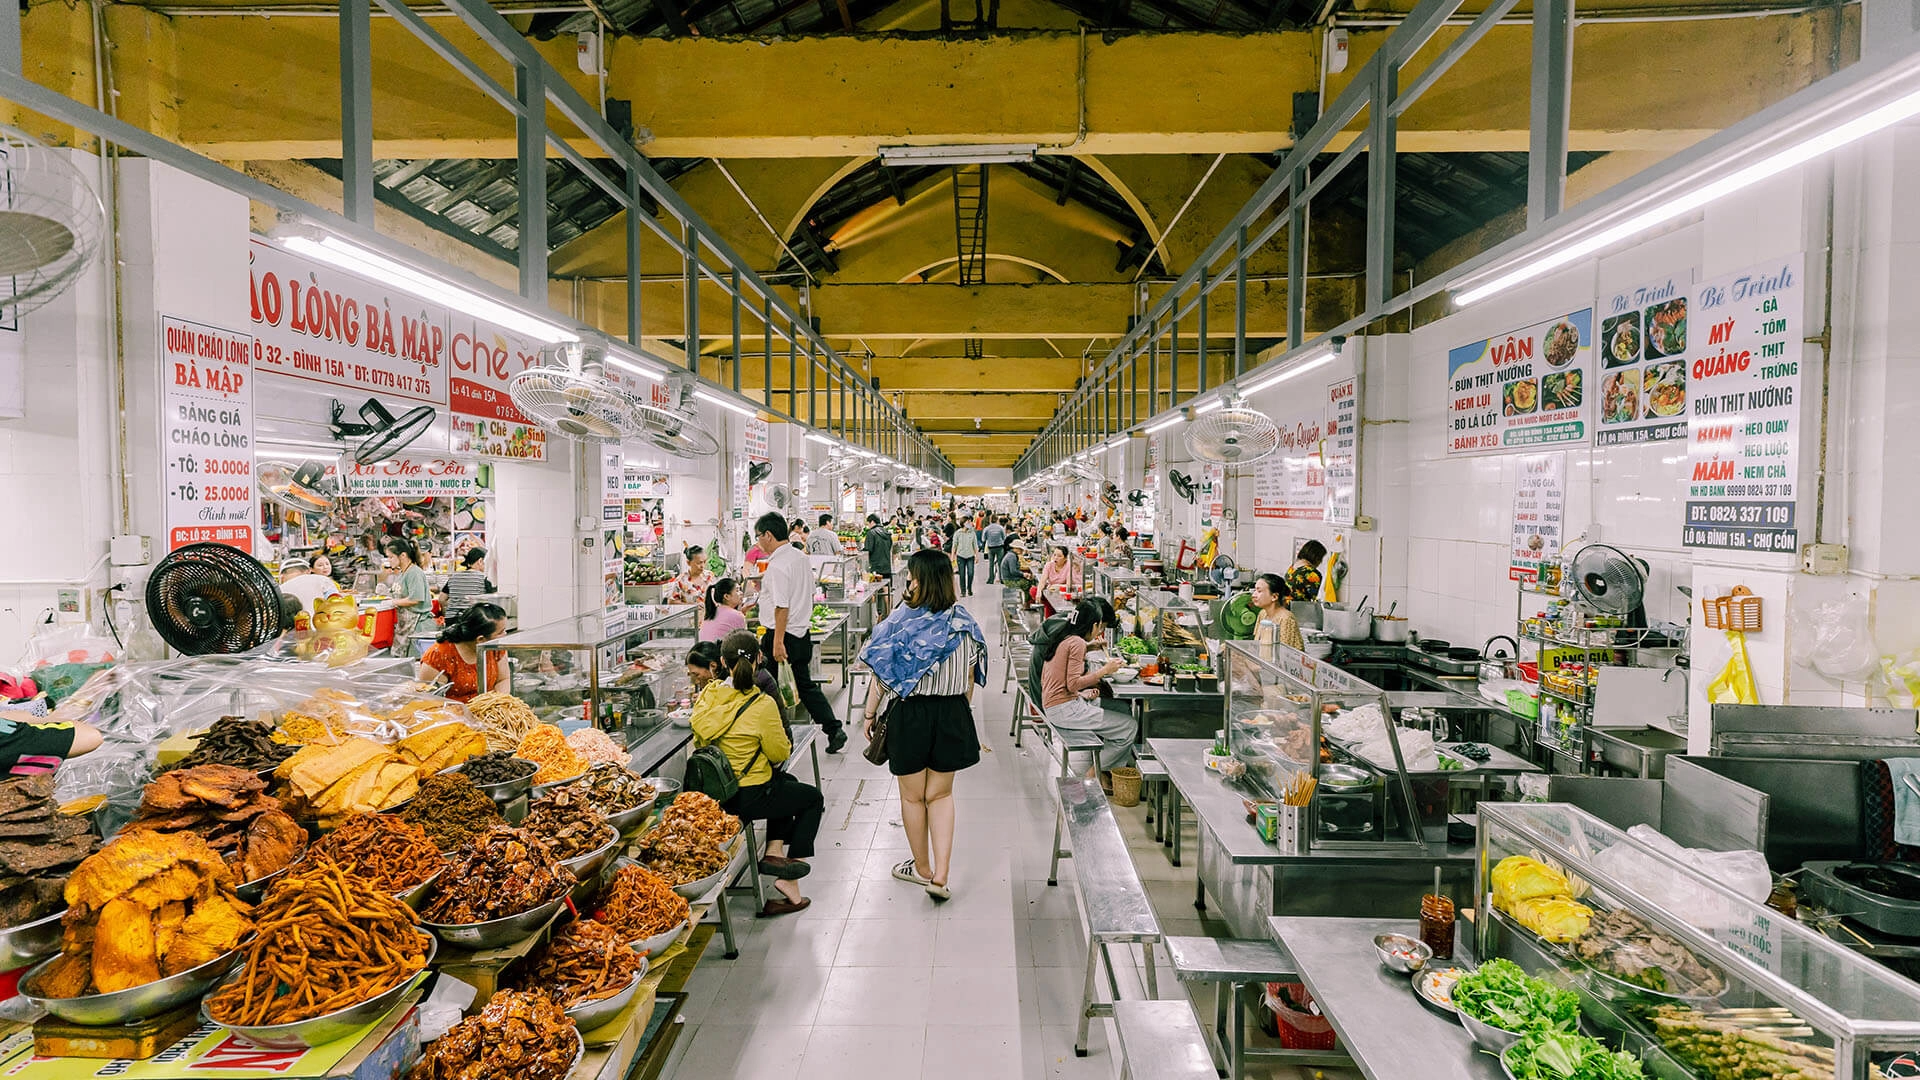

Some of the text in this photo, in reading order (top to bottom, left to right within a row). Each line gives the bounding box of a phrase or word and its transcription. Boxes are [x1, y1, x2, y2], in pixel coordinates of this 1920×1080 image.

[1732, 264, 1792, 302] Trinh
[1763, 296, 1778, 314] GÀ
[290, 272, 361, 347] LÒNG
[366, 297, 397, 357] BÀ
[402, 310, 443, 377] MẬP
[1761, 319, 1787, 336] TÔM
[167, 324, 249, 366] QUÁN CHÁO LÒNG
[1490, 336, 1534, 368] VÂN
[1761, 341, 1786, 360] THỊT
[267, 344, 282, 365] 32
[294, 349, 321, 374] ĐÌNH
[325, 359, 345, 378] 15A
[354, 368, 369, 384] ĐT:
[371, 370, 394, 389] 0779
[397, 375, 413, 392] 417
[415, 379, 429, 394] 375
[1692, 348, 1751, 381] QUẢNG
[1760, 361, 1798, 380] TRỨNG
[175, 359, 243, 398] BÀ MẬP
[1455, 363, 1532, 392] BÚN THỊT NƯỚNG
[1455, 394, 1491, 412] NEM LỤI
[1694, 385, 1793, 416] BÚN THỊT NƯỚNG
[179, 401, 241, 426] BẢNG GIÁ
[1455, 408, 1498, 430] BÒ LÁ LỐT
[171, 427, 248, 448] CHÁO LÒNG
[527, 427, 545, 443] Sinh
[1635, 429, 1649, 441] 15A
[1655, 426, 1671, 441] CHỢ
[1745, 419, 1789, 436] HEO QUAY
[1454, 432, 1478, 449] BÁNH
[1480, 432, 1498, 447] XÈO
[1744, 440, 1789, 458] HEO LUỘC
[178, 453, 249, 475] TÔ: 30.000đ
[383, 459, 467, 479] Chợ Cồn
[1692, 451, 1735, 481] MẮM
[1744, 460, 1786, 480] NEM CHẢ
[178, 481, 249, 501] TÔ: 25.000đ
[405, 480, 423, 489] SINH
[1747, 484, 1763, 497] 0824
[1764, 484, 1777, 496] 337
[1779, 484, 1792, 496] 109
[1691, 506, 1788, 523] ĐT: 0824 337 109
[201, 530, 210, 541] 32
[235, 529, 248, 540] 15A
[1684, 528, 1796, 552] LÔ 04 ĐÌNH 15A CHỢ CỒN
[1589, 649, 1609, 662] GIÁ
